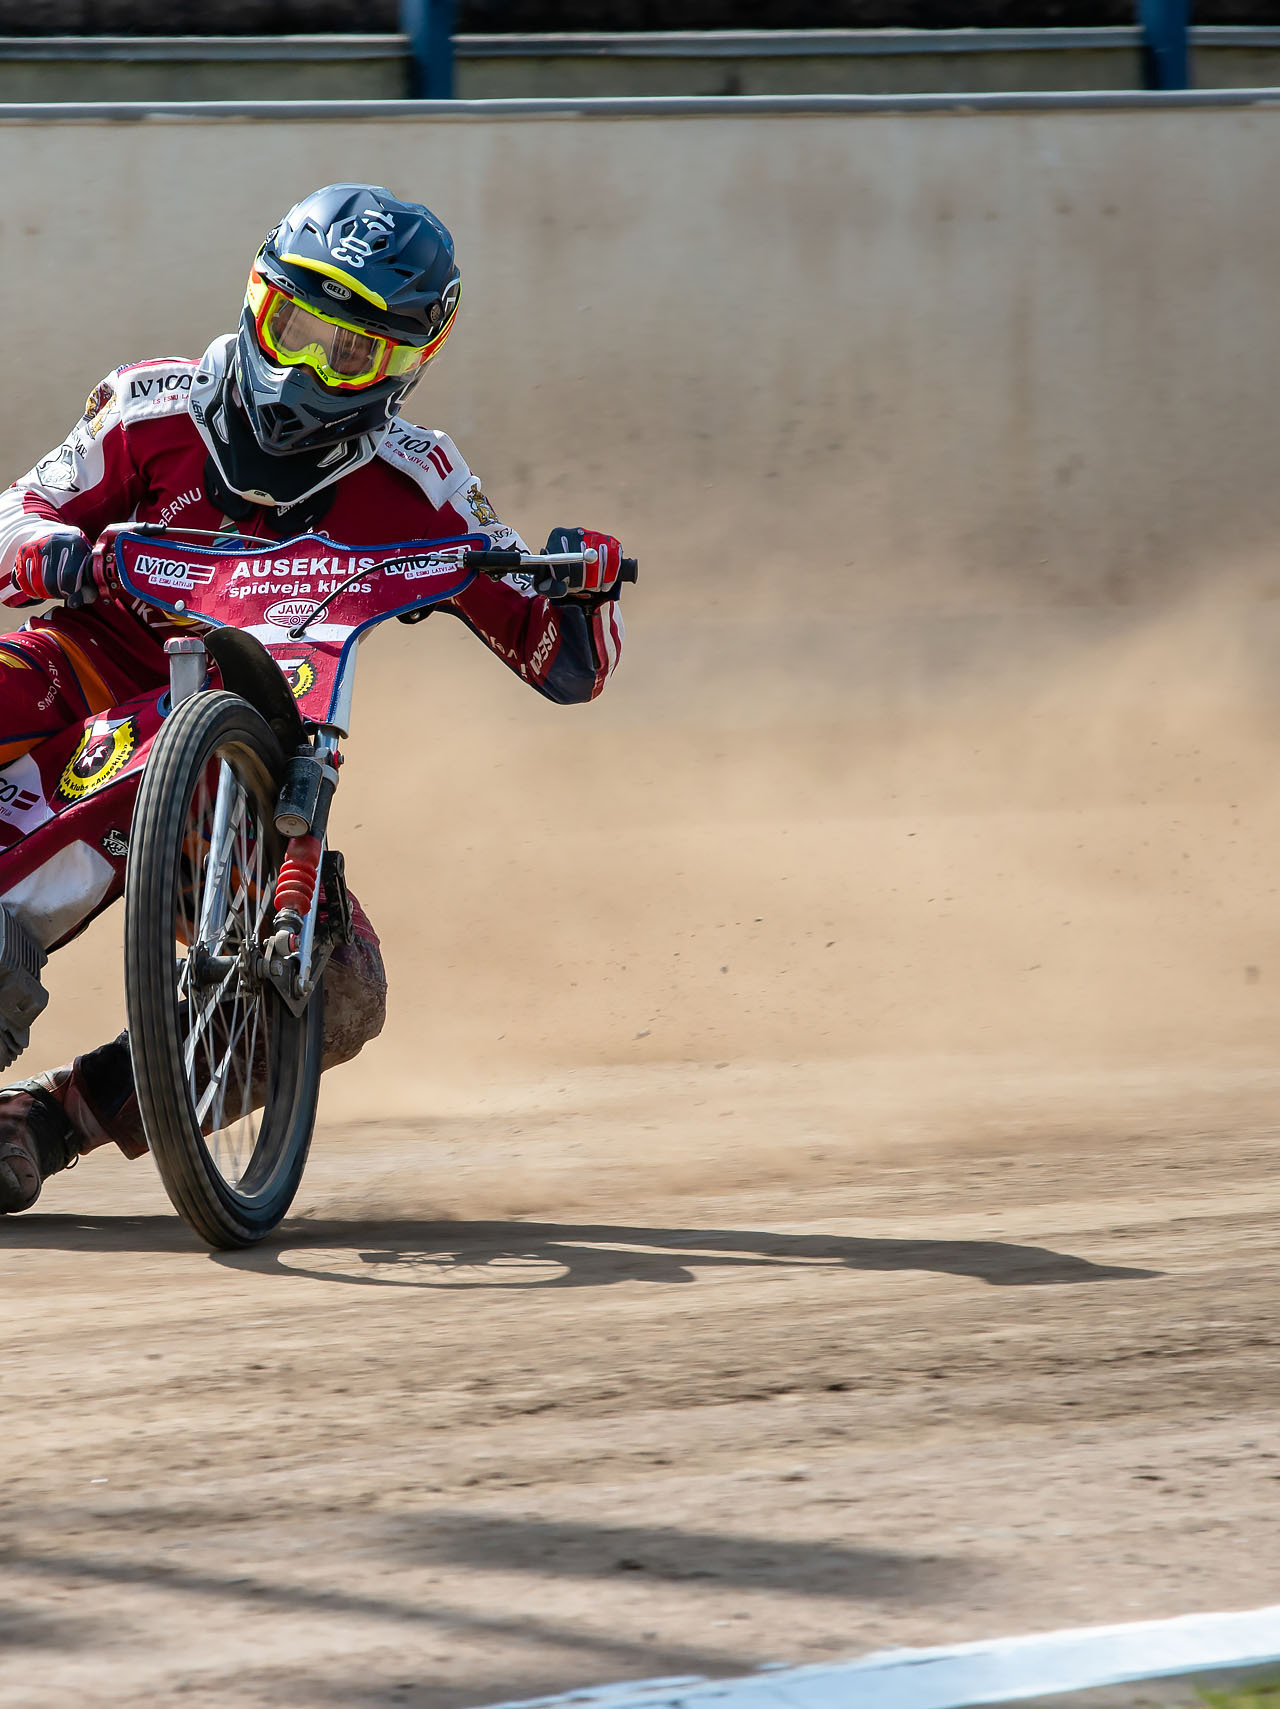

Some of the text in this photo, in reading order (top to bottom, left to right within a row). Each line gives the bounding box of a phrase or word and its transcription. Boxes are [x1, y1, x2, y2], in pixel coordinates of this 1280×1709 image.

[326, 283, 347, 297] BELL
[191, 400, 207, 428] LEATT
[388, 421, 431, 454] V100
[231, 557, 375, 580] AUSEKLIS
[229, 581, 311, 599] spīdveja
[277, 604, 315, 615] JAWA
